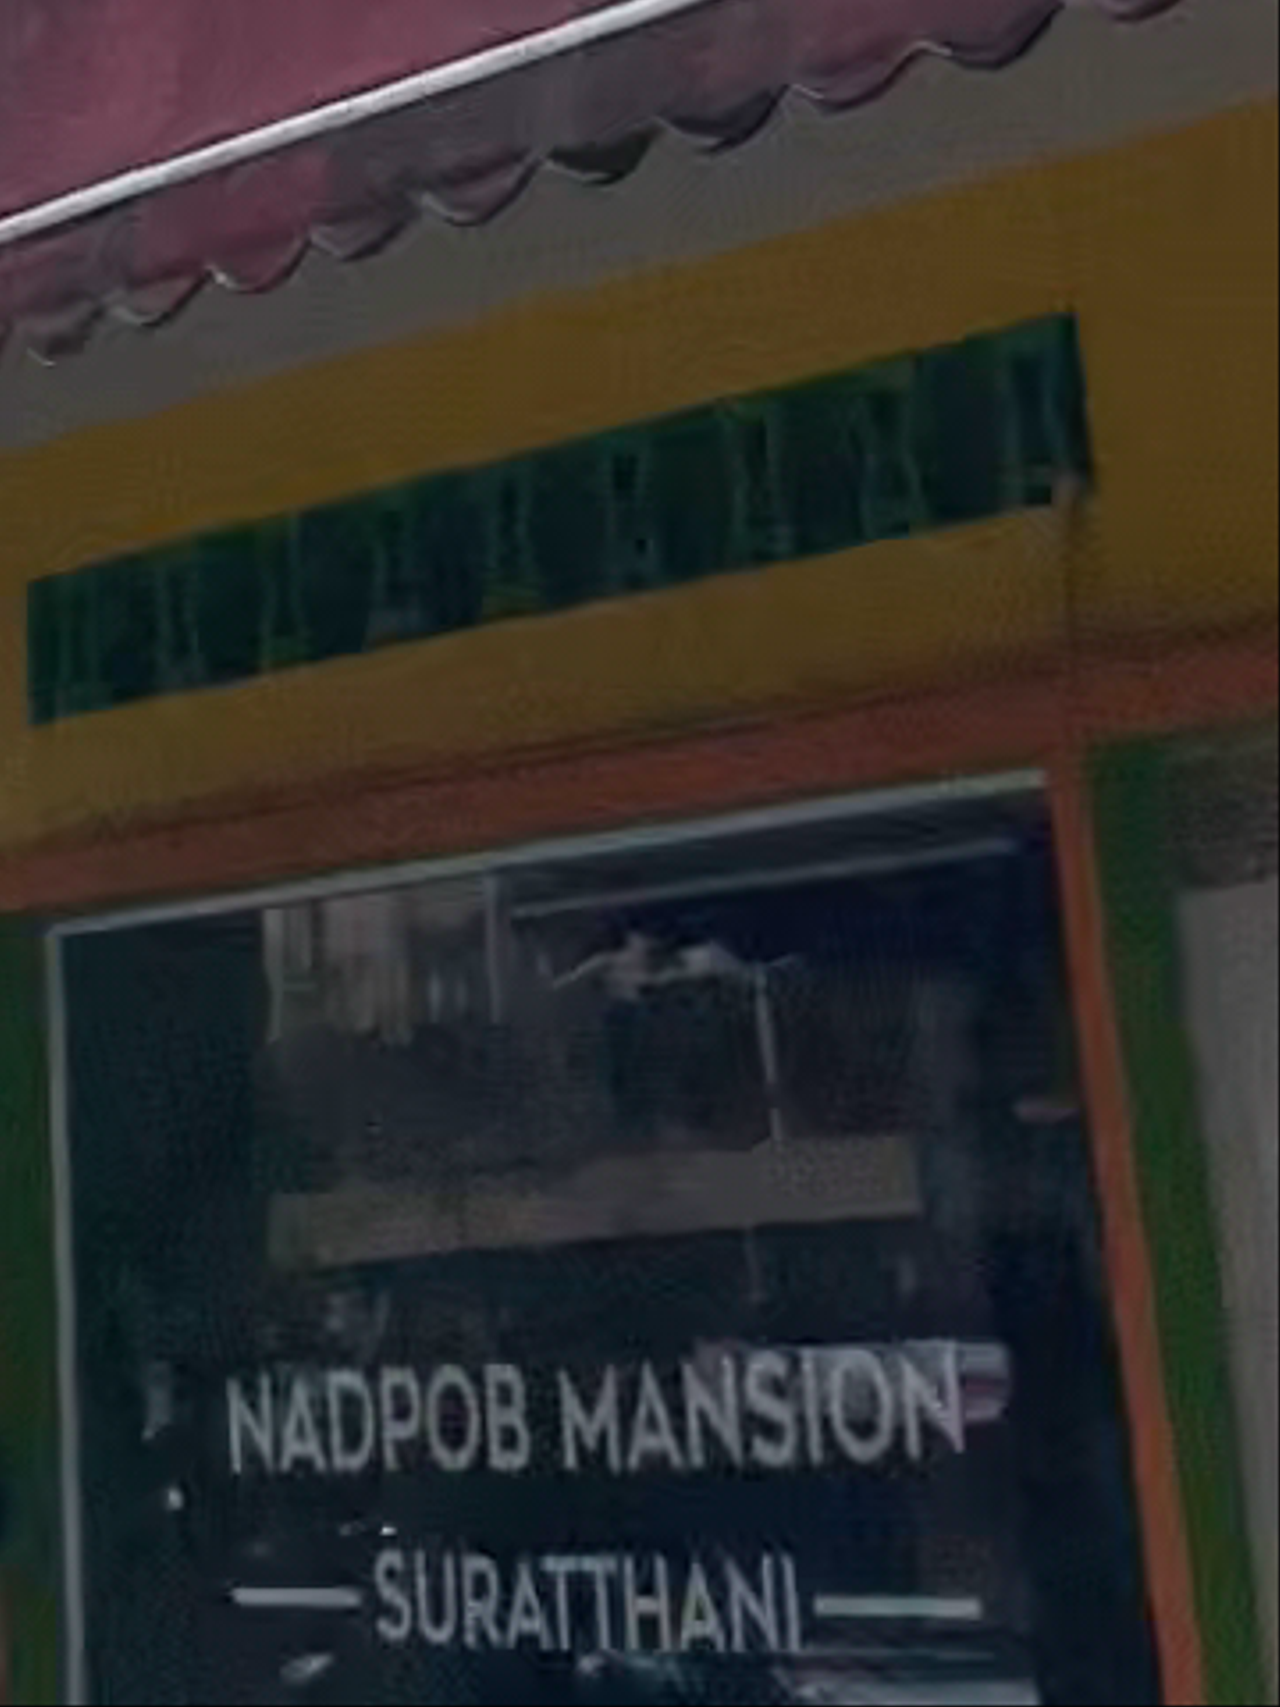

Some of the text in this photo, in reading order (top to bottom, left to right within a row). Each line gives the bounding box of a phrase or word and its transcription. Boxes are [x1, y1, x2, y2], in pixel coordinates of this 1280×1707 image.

[225, 1339, 967, 1474] NADPOB MANSION
[374, 1549, 803, 1653] SURATTHANI
